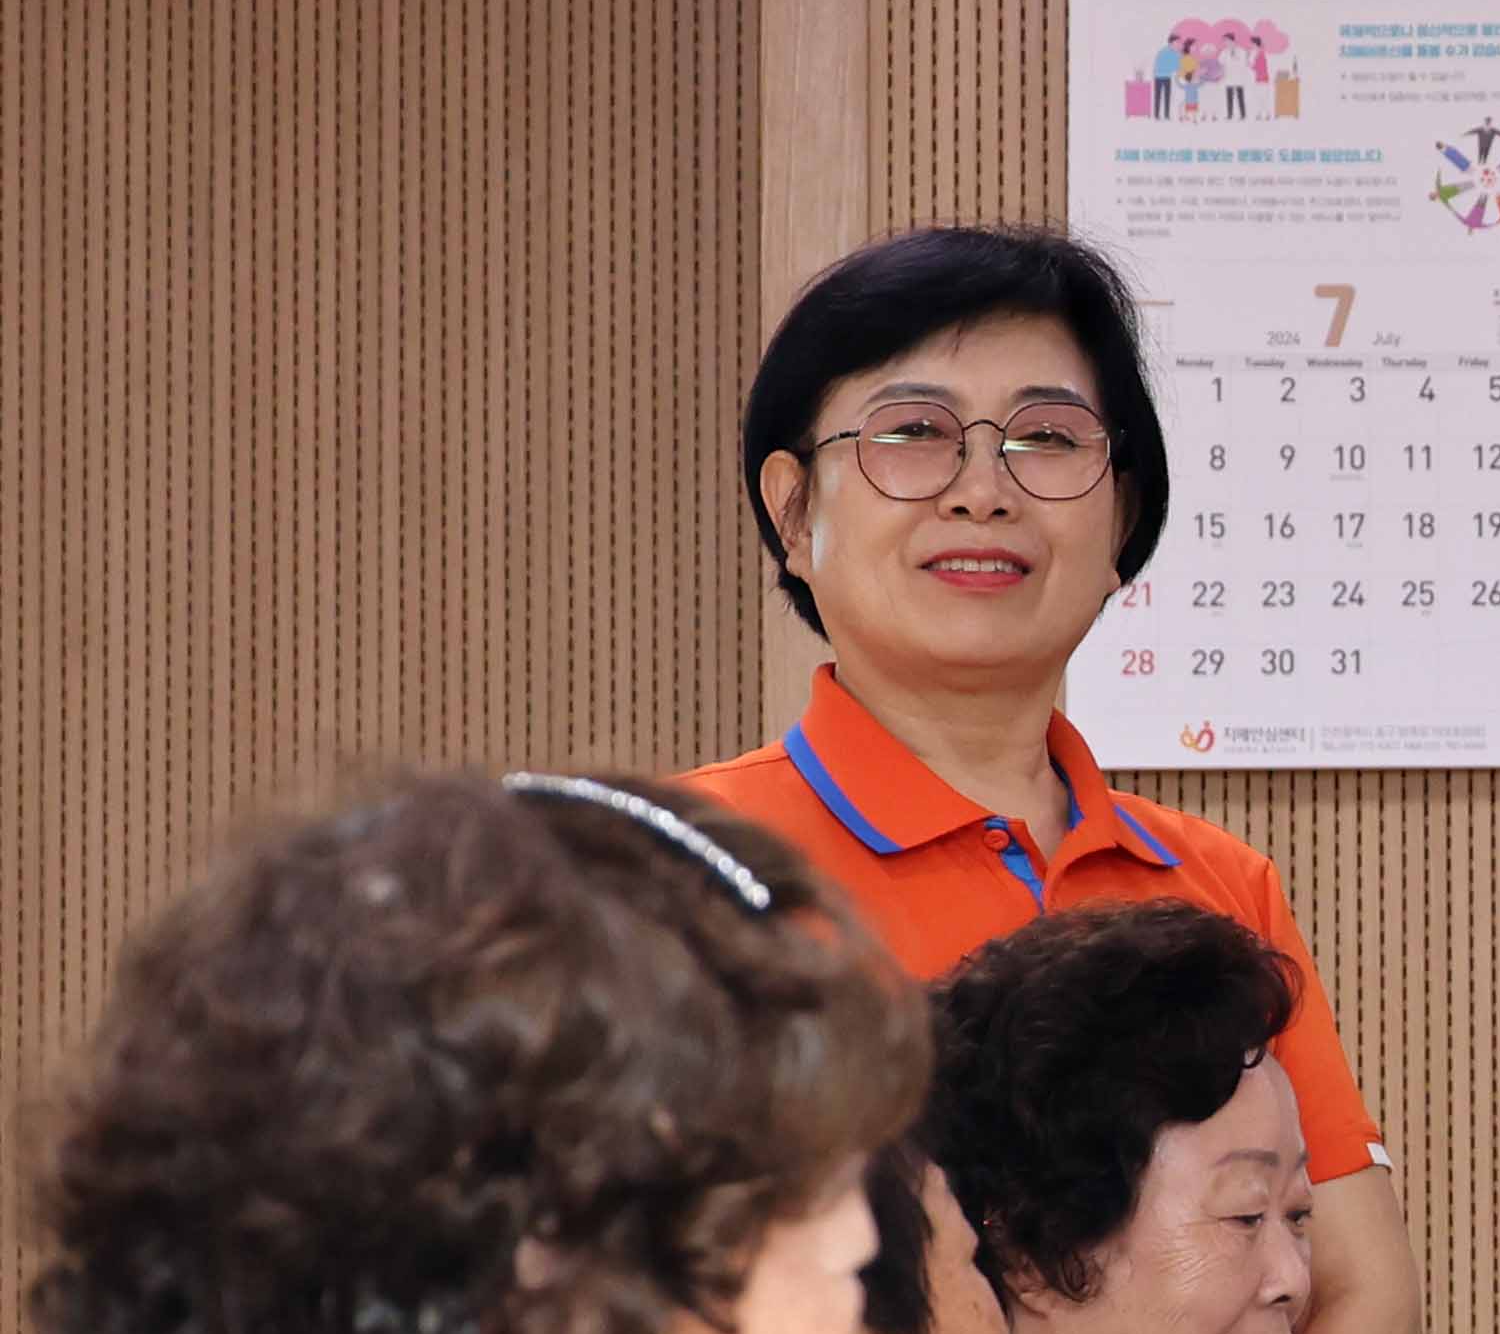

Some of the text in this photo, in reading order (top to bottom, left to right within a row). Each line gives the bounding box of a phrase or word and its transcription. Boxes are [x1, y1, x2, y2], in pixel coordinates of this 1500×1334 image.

[1266, 283, 1402, 348] 2024 7 July
[1211, 376, 1223, 403] 1
[1280, 376, 1297, 403] 2
[1349, 376, 1366, 403] 3
[1418, 376, 1436, 402] 4
[1209, 444, 1226, 472] 8
[1279, 444, 1296, 471] 9
[1334, 444, 1366, 471] 10
[1403, 444, 1432, 471] 11
[1194, 512, 1226, 540] 15
[1264, 512, 1296, 540] 16
[1333, 512, 1366, 539] 17
[1403, 512, 1436, 539] 18
[1121, 581, 1152, 608] 21
[1191, 580, 1225, 608] 22
[1261, 580, 1296, 608] 23
[1331, 580, 1366, 608] 24
[1401, 580, 1435, 608] 25
[1121, 648, 1361, 676] 28 29 30 31
